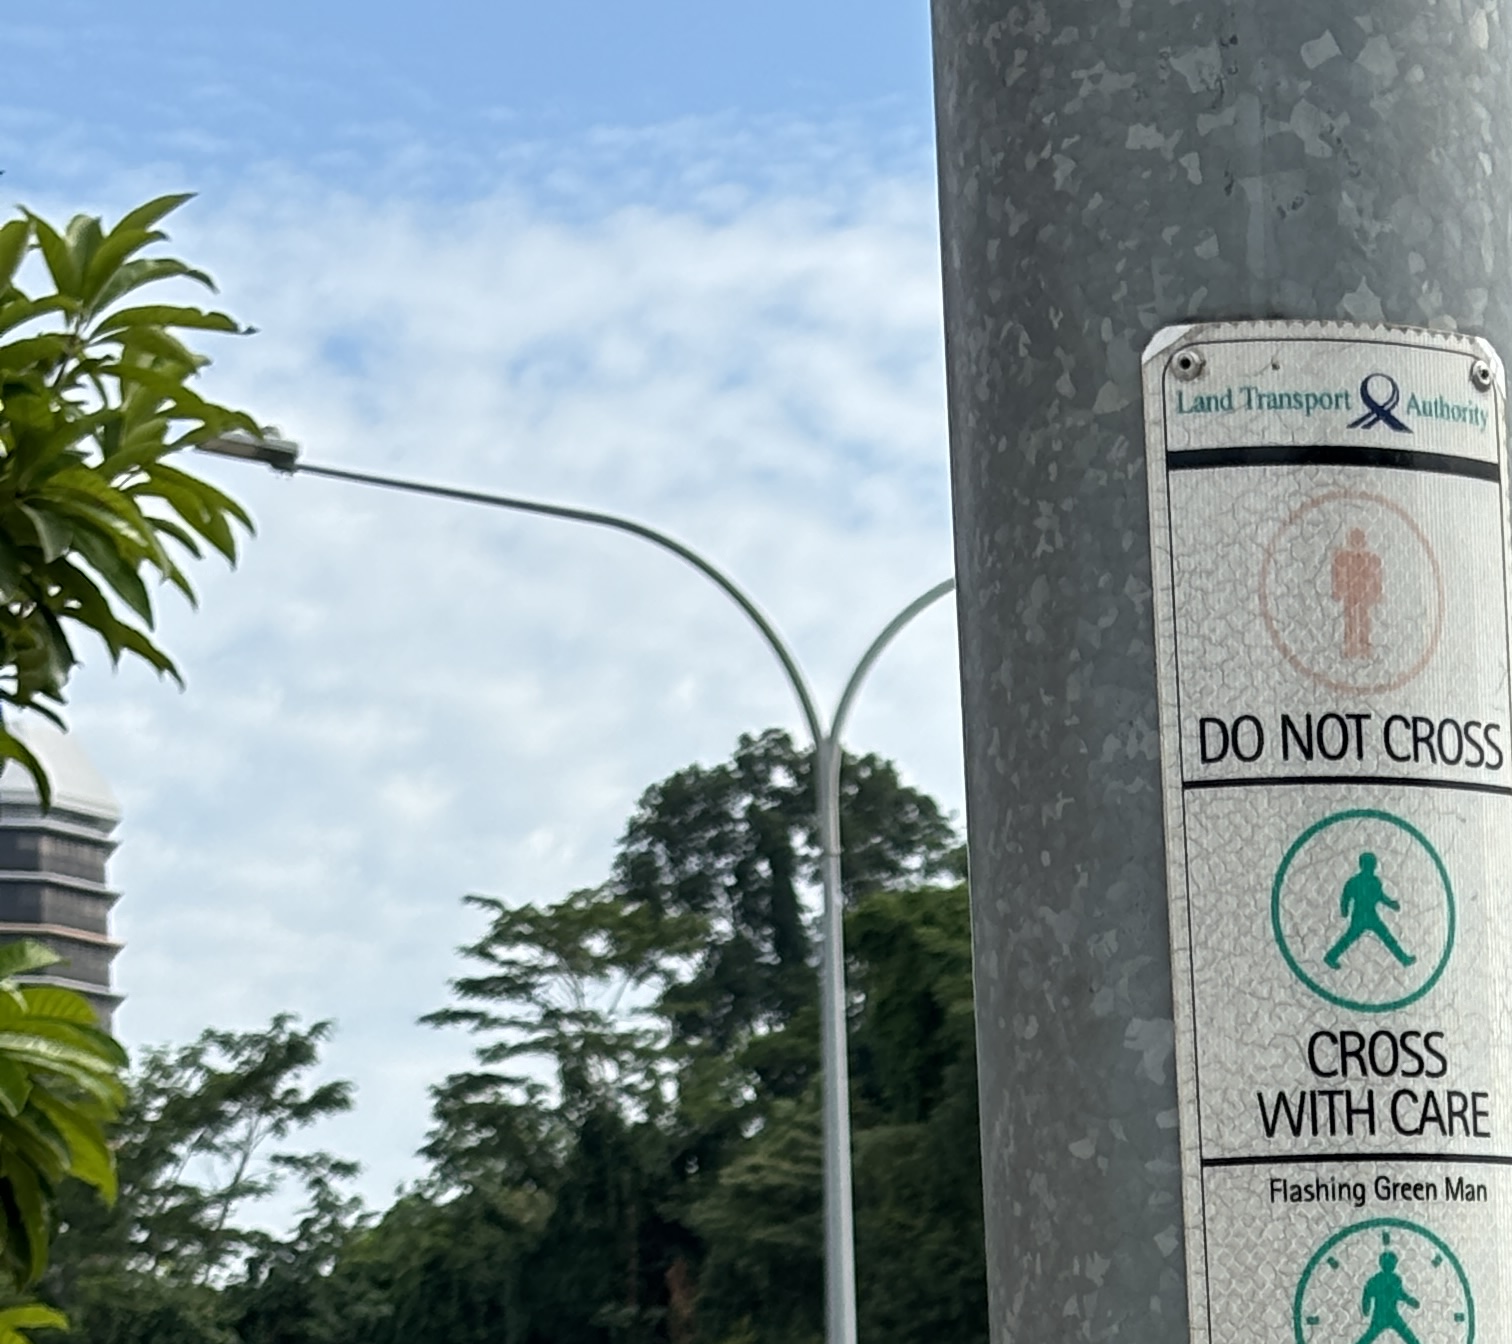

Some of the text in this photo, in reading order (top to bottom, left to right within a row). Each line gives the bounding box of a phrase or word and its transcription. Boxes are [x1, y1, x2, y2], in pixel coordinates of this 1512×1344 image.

[1176, 386, 1489, 431] Land Transport Authority
[1199, 713, 1503, 770] DO NOT CROSS
[1307, 1030, 1448, 1079] CROSS
[1257, 1089, 1491, 1138] WITH CARE
[1269, 1175, 1488, 1207] Flashing Green Man
